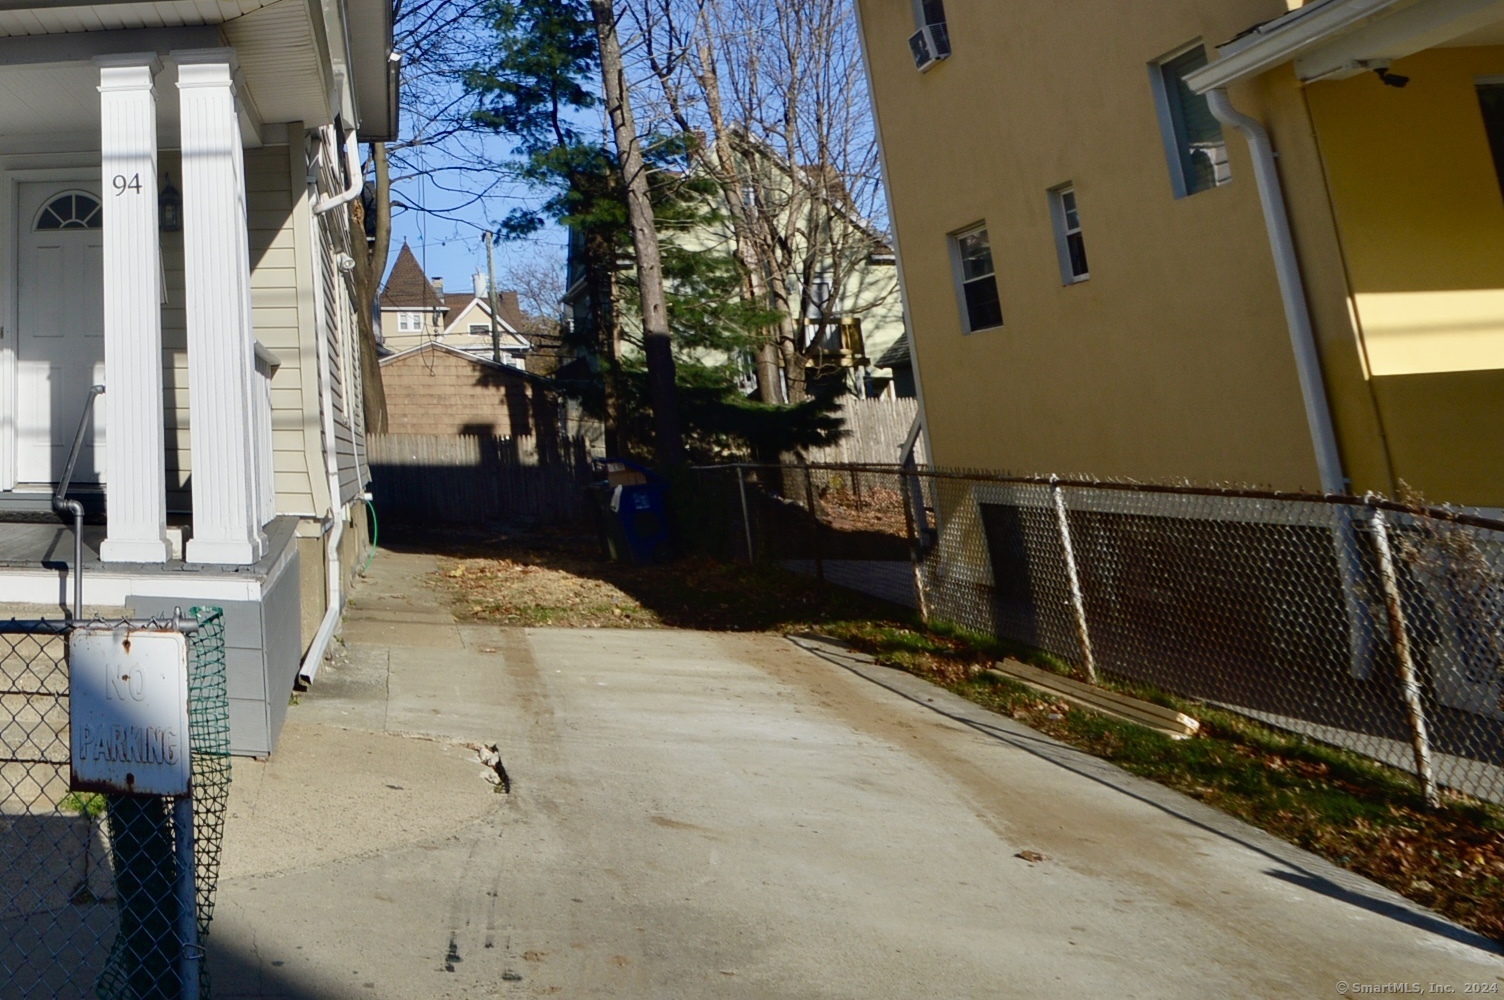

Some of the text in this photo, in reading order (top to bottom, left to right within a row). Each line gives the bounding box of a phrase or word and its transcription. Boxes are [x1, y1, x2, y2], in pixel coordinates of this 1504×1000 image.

[112, 172, 143, 197] 94
[106, 663, 146, 702] NO
[79, 724, 178, 766] PARKING
